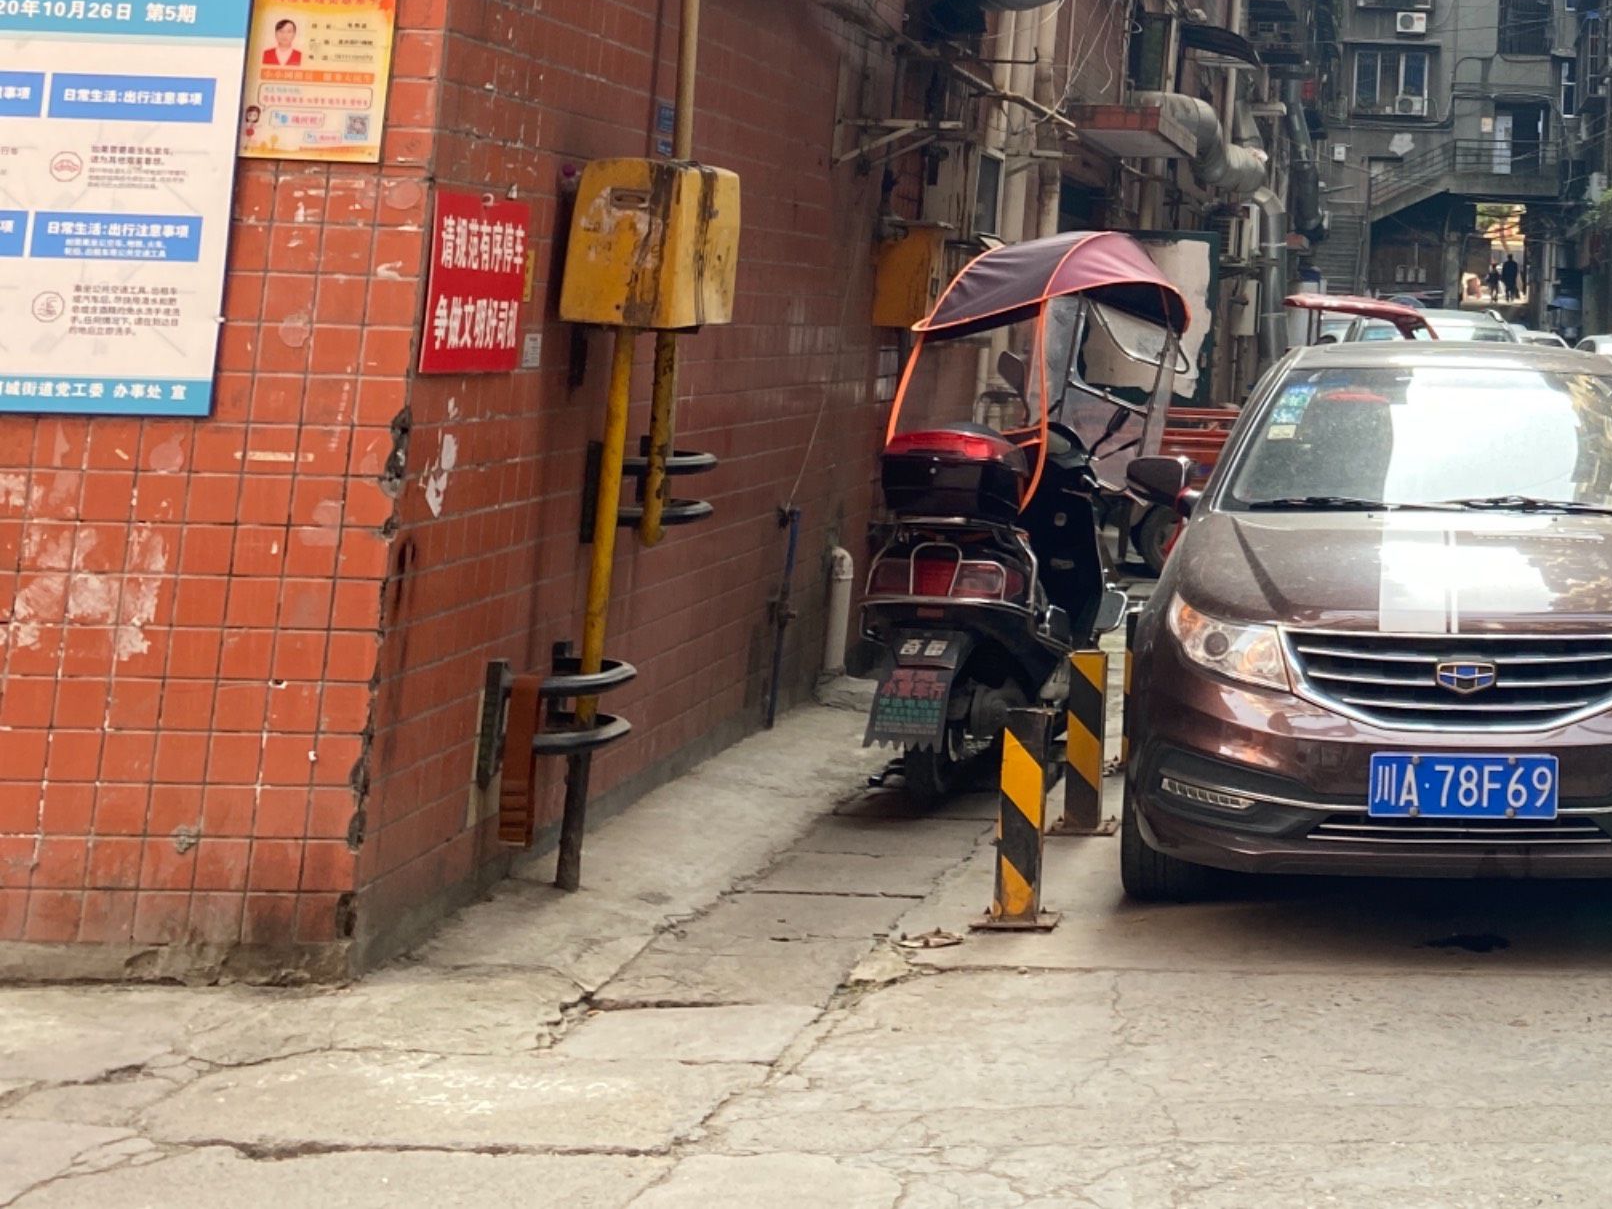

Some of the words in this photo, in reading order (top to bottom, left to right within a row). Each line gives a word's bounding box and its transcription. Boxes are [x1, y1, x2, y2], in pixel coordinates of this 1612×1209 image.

[145, 2, 197, 24] 第5期
[0, 86, 31, 100] 事项
[441, 215, 526, 274] 请规范有序停车
[433, 294, 519, 350] 争做文明好司机
[0, 381, 104, 399] 城街道党工委
[113, 383, 162, 400] 办事处
